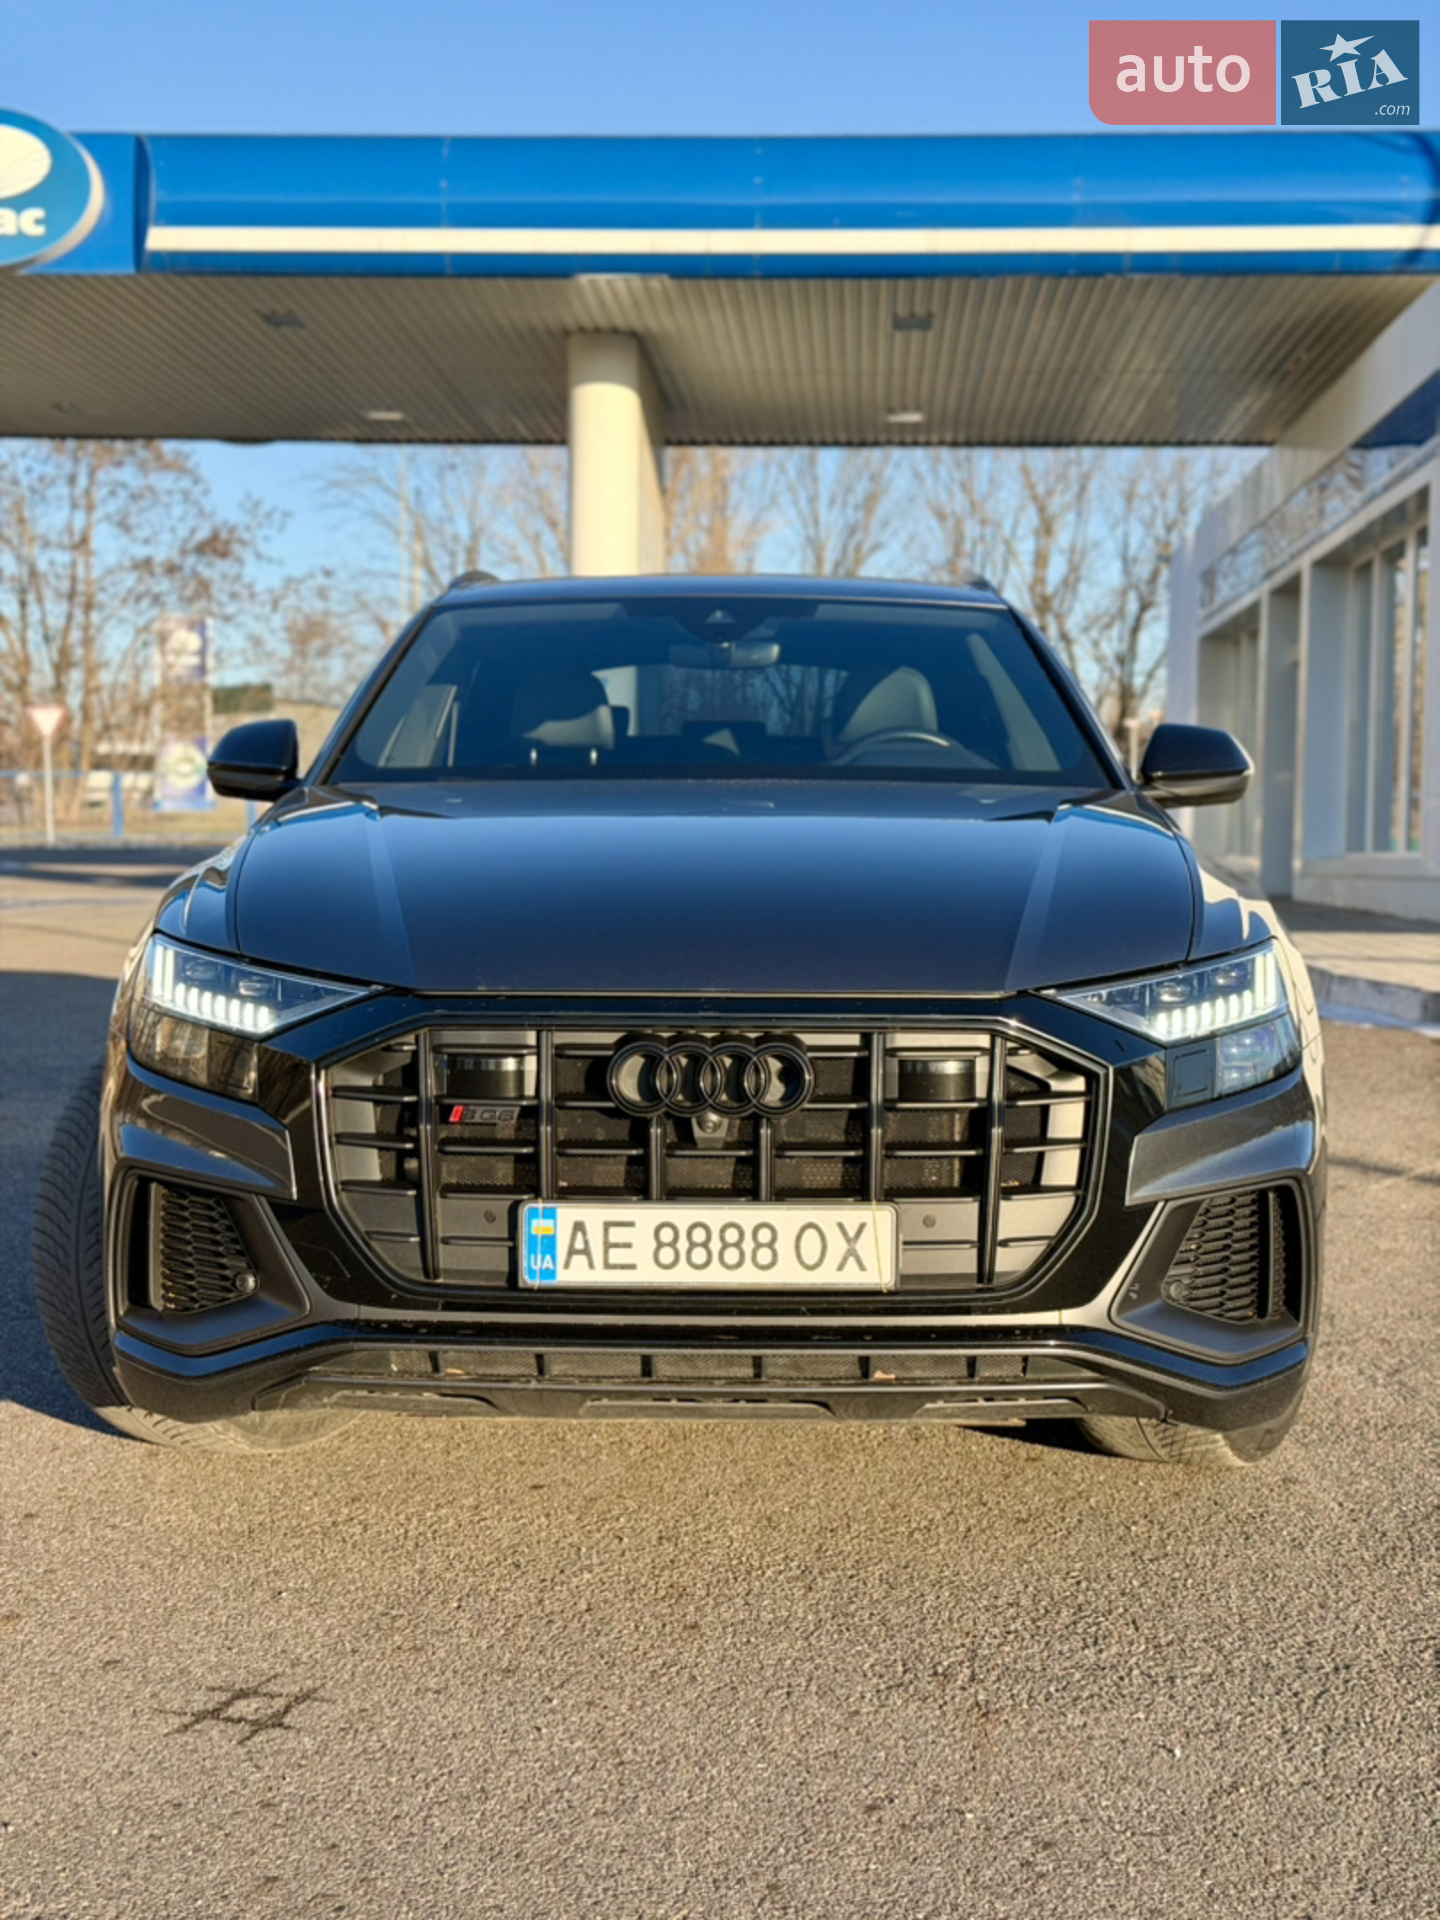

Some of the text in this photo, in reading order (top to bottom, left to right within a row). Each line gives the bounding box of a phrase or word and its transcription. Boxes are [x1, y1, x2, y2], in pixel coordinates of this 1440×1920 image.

[530, 1253, 555, 1270] UA
[563, 1220, 868, 1272] AE 8888 OX
